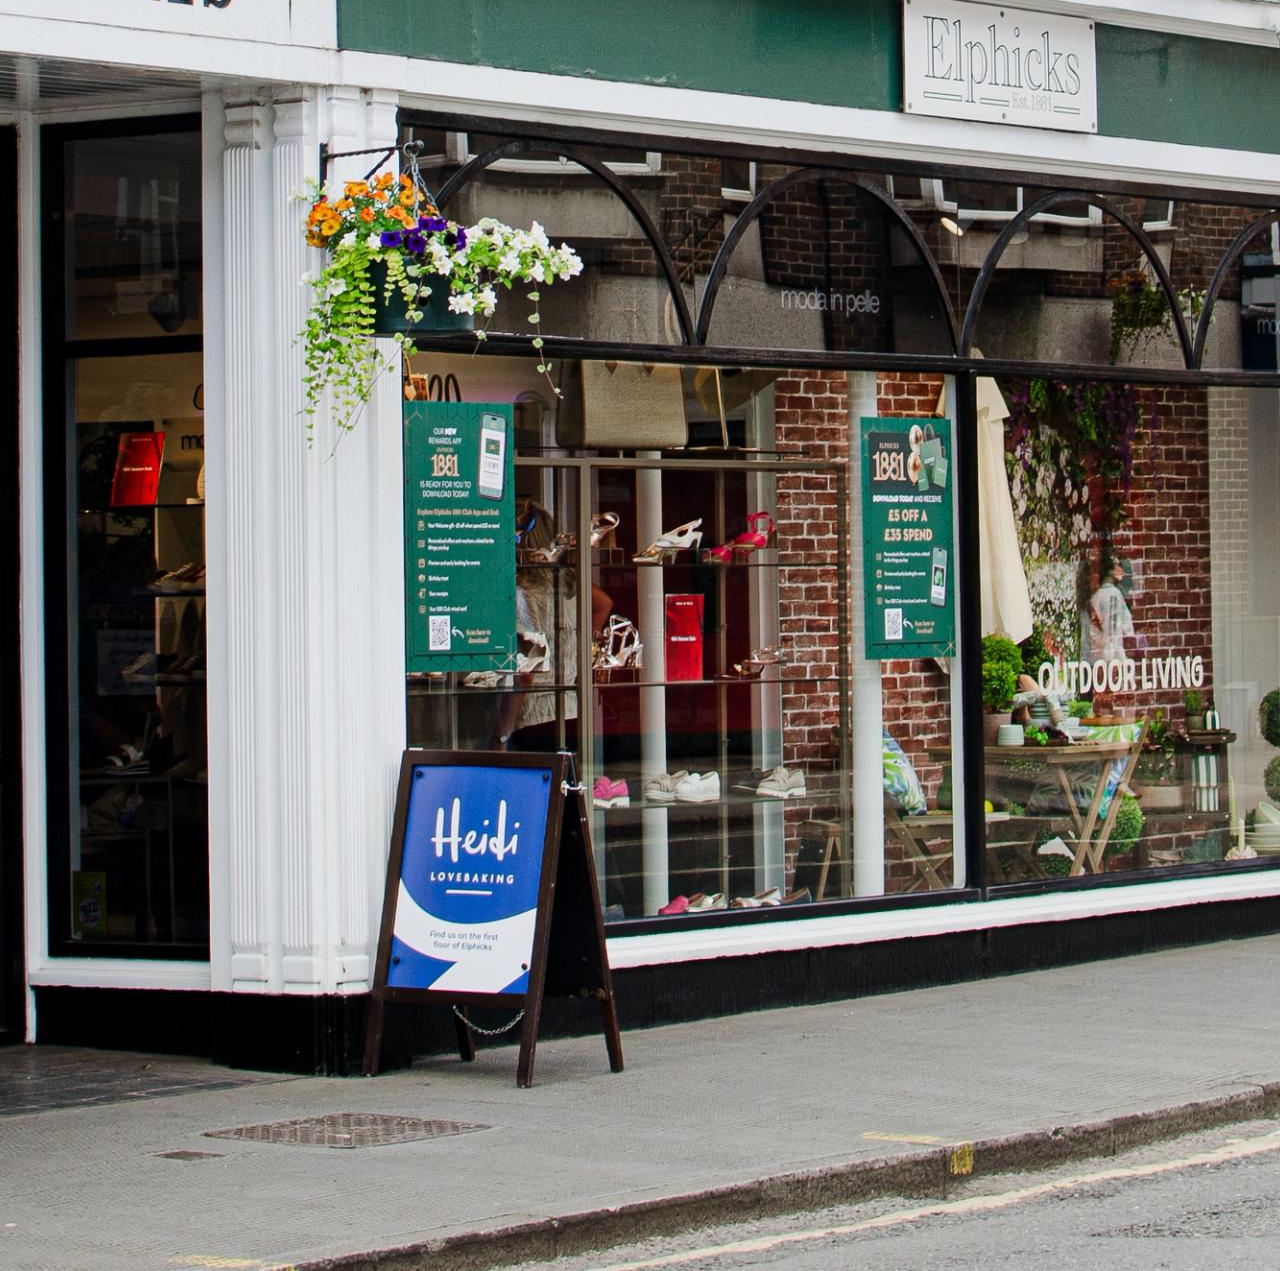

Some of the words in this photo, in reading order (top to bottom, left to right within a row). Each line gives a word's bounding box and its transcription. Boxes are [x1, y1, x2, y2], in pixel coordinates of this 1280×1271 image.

[923, 15, 1081, 103] Elphicks
[1012, 92, 1053, 112] Est.1881
[781, 286, 828, 311] moda
[830, 288, 843, 311] in
[845, 290, 880, 318] pelle
[431, 454, 460, 477] 1881
[872, 451, 907, 481] 1881
[888, 509, 900, 522] £5
[901, 509, 920, 522] OFF
[921, 509, 928, 522] A
[884, 528, 902, 541] £35
[903, 528, 933, 541] SPEND
[1038, 658, 1137, 697] OUTDOOR
[1141, 655, 1204, 690] LIVING
[430, 797, 520, 863] Heidi
[430, 871, 515, 884] LOVEBAKING
[429, 930, 446, 939] Find
[469, 932, 482, 940] the
[483, 932, 498, 941] first
[461, 942, 493, 953] Elphicks
